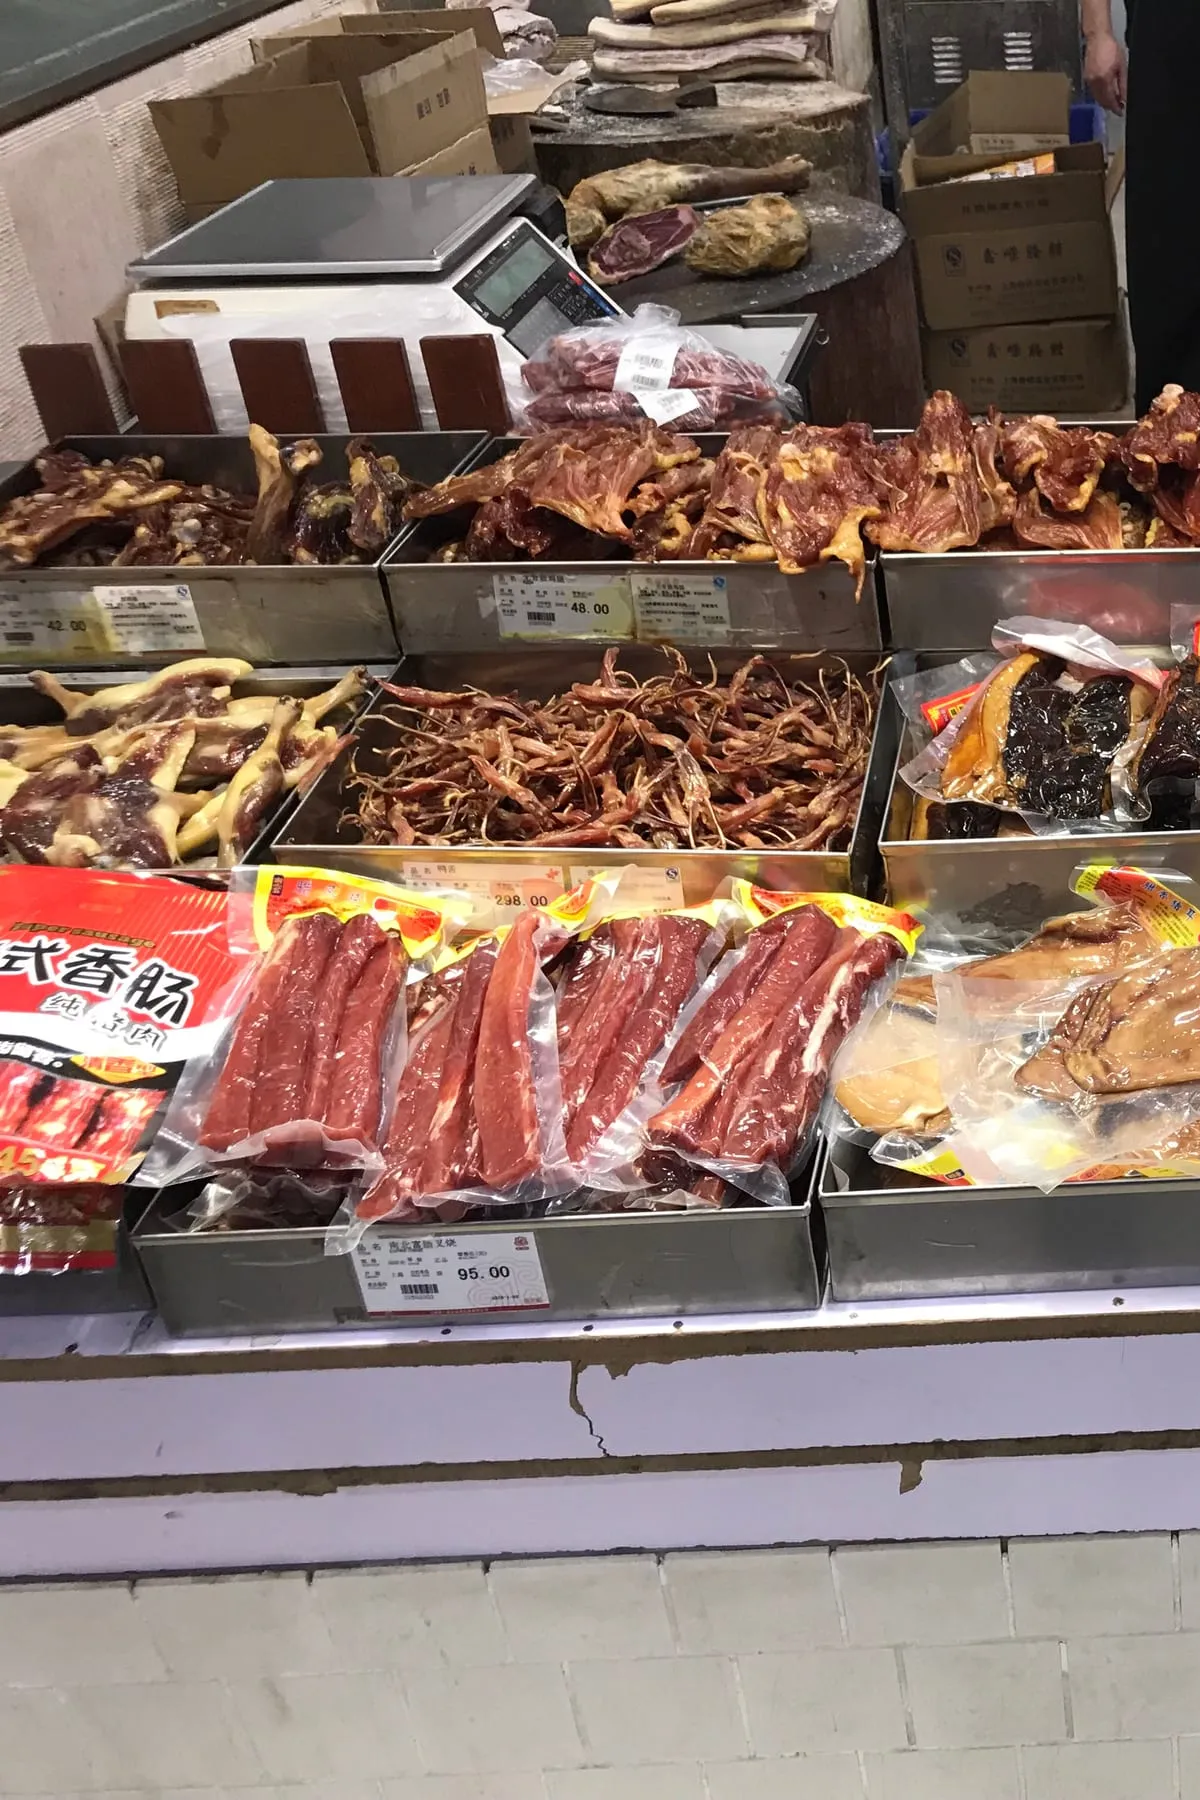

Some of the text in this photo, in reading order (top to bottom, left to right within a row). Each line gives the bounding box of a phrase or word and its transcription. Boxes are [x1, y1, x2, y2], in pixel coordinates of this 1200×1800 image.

[571, 602, 609, 615] 48.00
[48, 620, 86, 631] 42.00
[437, 865, 456, 873] 鸭舌
[496, 895, 548, 907] 298.00
[458, 1266, 510, 1280] 95.00
